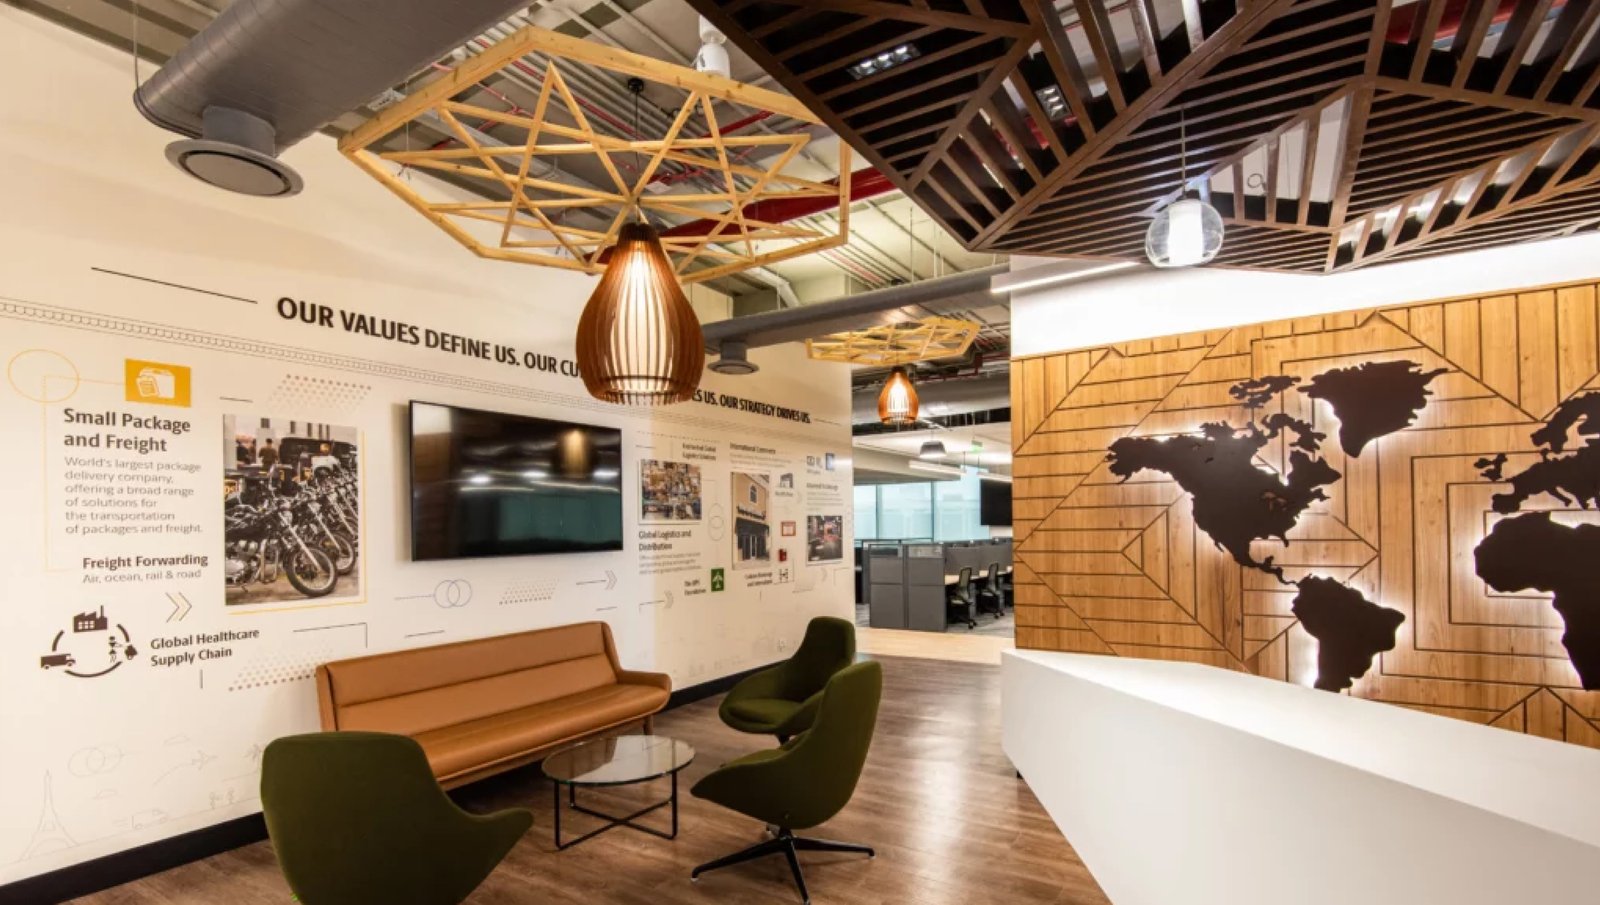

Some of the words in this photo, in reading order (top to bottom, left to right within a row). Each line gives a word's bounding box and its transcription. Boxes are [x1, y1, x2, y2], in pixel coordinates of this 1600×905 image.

[277, 297, 334, 328] OUR
[341, 309, 420, 345] VALUES
[424, 328, 491, 360] DEFINE
[495, 345, 521, 367] US.
[524, 351, 557, 374] OUR
[560, 359, 581, 379] CU
[691, 388, 703, 402] ES
[704, 391, 718, 406] US.
[719, 394, 739, 410] OUR
[738, 398, 776, 417] STRATEGY
[776, 407, 800, 422] DRIVES
[64, 408, 116, 426] Small
[122, 413, 191, 435] Package
[64, 433, 100, 448] and
[106, 434, 167, 454] Freight
[64, 456, 112, 468] World's
[115, 459, 153, 471] largest
[157, 461, 202, 474] package
[64, 470, 115, 483] delivery
[117, 473, 174, 484] company,
[65, 484, 114, 496] offering
[127, 485, 161, 496] broad
[164, 487, 194, 498] range
[65, 497, 79, 507] of
[82, 498, 138, 508] solutions
[141, 497, 157, 508] for
[66, 511, 87, 521] the
[90, 511, 175, 522] transportation
[65, 524, 79, 534] of
[82, 525, 138, 536] packages
[141, 524, 163, 533] and
[165, 524, 203, 535] freight.
[639, 530, 657, 539] Global
[659, 530, 681, 540] Logistics
[639, 543, 672, 552] Distribution
[82, 556, 132, 571] Freight
[136, 554, 209, 568] Forwarding
[82, 574, 102, 584] Air,
[105, 572, 143, 583] ocean,
[146, 570, 162, 580] rail
[165, 570, 174, 579] &
[176, 569, 202, 579] road
[150, 635, 193, 650] Global
[196, 629, 260, 644] Healthcare
[150, 652, 196, 668] Supply
[198, 647, 233, 660] Chain
